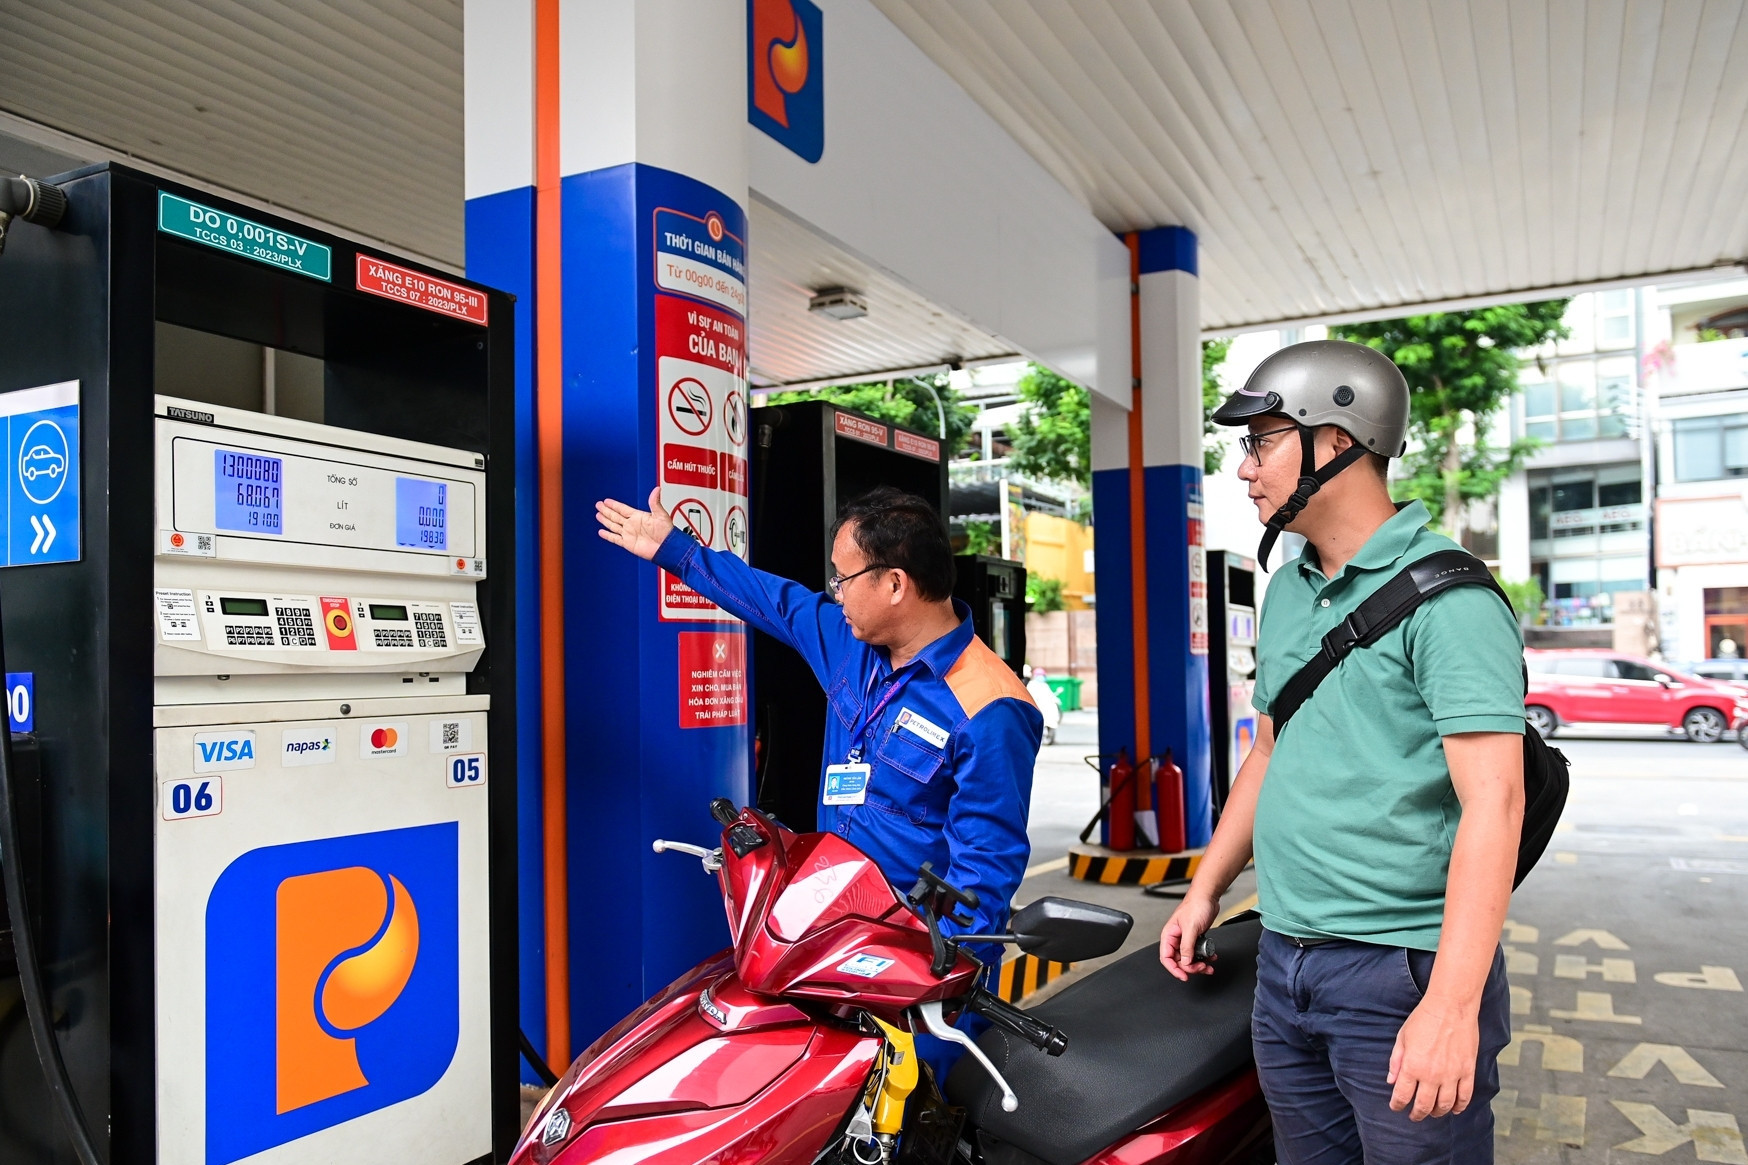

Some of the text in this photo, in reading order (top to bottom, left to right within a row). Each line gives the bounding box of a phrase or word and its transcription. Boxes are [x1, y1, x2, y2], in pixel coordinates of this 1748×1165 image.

[190, 206, 307, 256] DO 0,001S-V
[195, 227, 227, 245] TCCS
[231, 239, 243, 251] 03
[253, 246, 302, 269] 2023/PLX
[664, 232, 692, 251] THỜI
[695, 241, 715, 260] GIAN
[717, 250, 731, 268] BÁN
[369, 265, 478, 307] XĂNG E10 RON 95-III
[667, 264, 683, 278] Từ
[686, 269, 713, 288] 00g00
[716, 281, 729, 295] đến
[381, 282, 407, 297] TCCS
[410, 291, 420, 300] 07
[428, 297, 467, 314] 2023/PLX
[688, 311, 738, 340] VÌ SỰ AN TOÀN
[689, 331, 738, 368] CỦA BẠN
[169, 407, 212, 422] TATSUNO
[223, 454, 279, 483] 1300080
[668, 459, 716, 475] CẤM HÚT THUỐC
[337, 500, 348, 509] LÍT
[439, 486, 444, 505] 0
[330, 522, 343, 530] ĐƠN
[419, 506, 444, 528] 0,000
[420, 530, 444, 544] 19830
[666, 593, 680, 604] ĐIỆN
[692, 669, 717, 678] NGHIÊM
[695, 710, 710, 719] TRÁI
[712, 709, 727, 718] PHÁP
[910, 718, 945, 743] PETROLIMEX
[195, 740, 253, 762] VISA
[286, 740, 320, 754] napas
[453, 758, 480, 783] 05
[173, 782, 212, 813] 06
